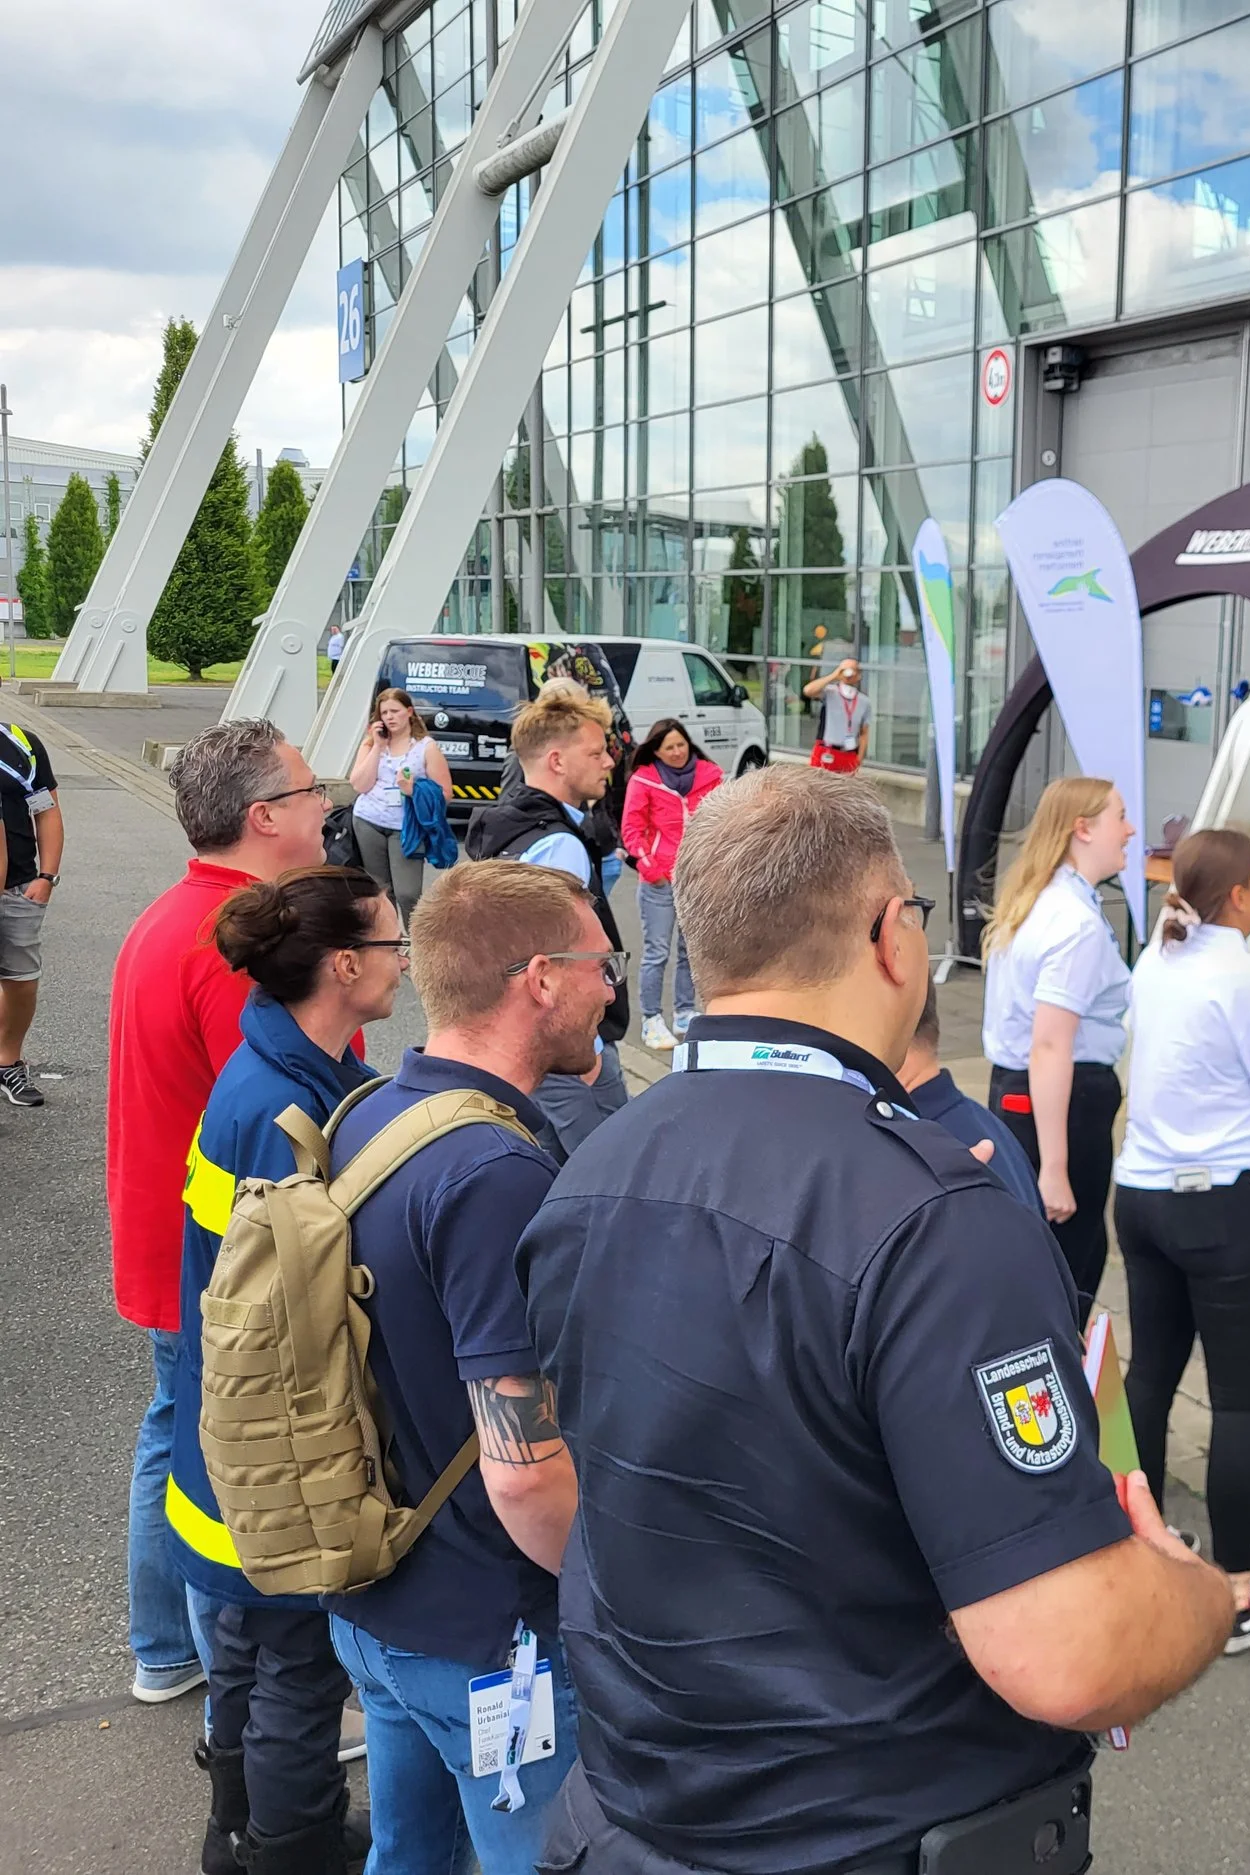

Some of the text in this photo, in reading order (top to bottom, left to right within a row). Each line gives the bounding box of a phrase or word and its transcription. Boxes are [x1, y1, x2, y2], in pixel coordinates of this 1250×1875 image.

[339, 283, 361, 355] 26
[449, 687, 470, 695] TEAM
[770, 1049, 813, 1062] Bullard
[981, 1351, 1049, 1386] Landesschule
[477, 1700, 504, 1715] Ronald
